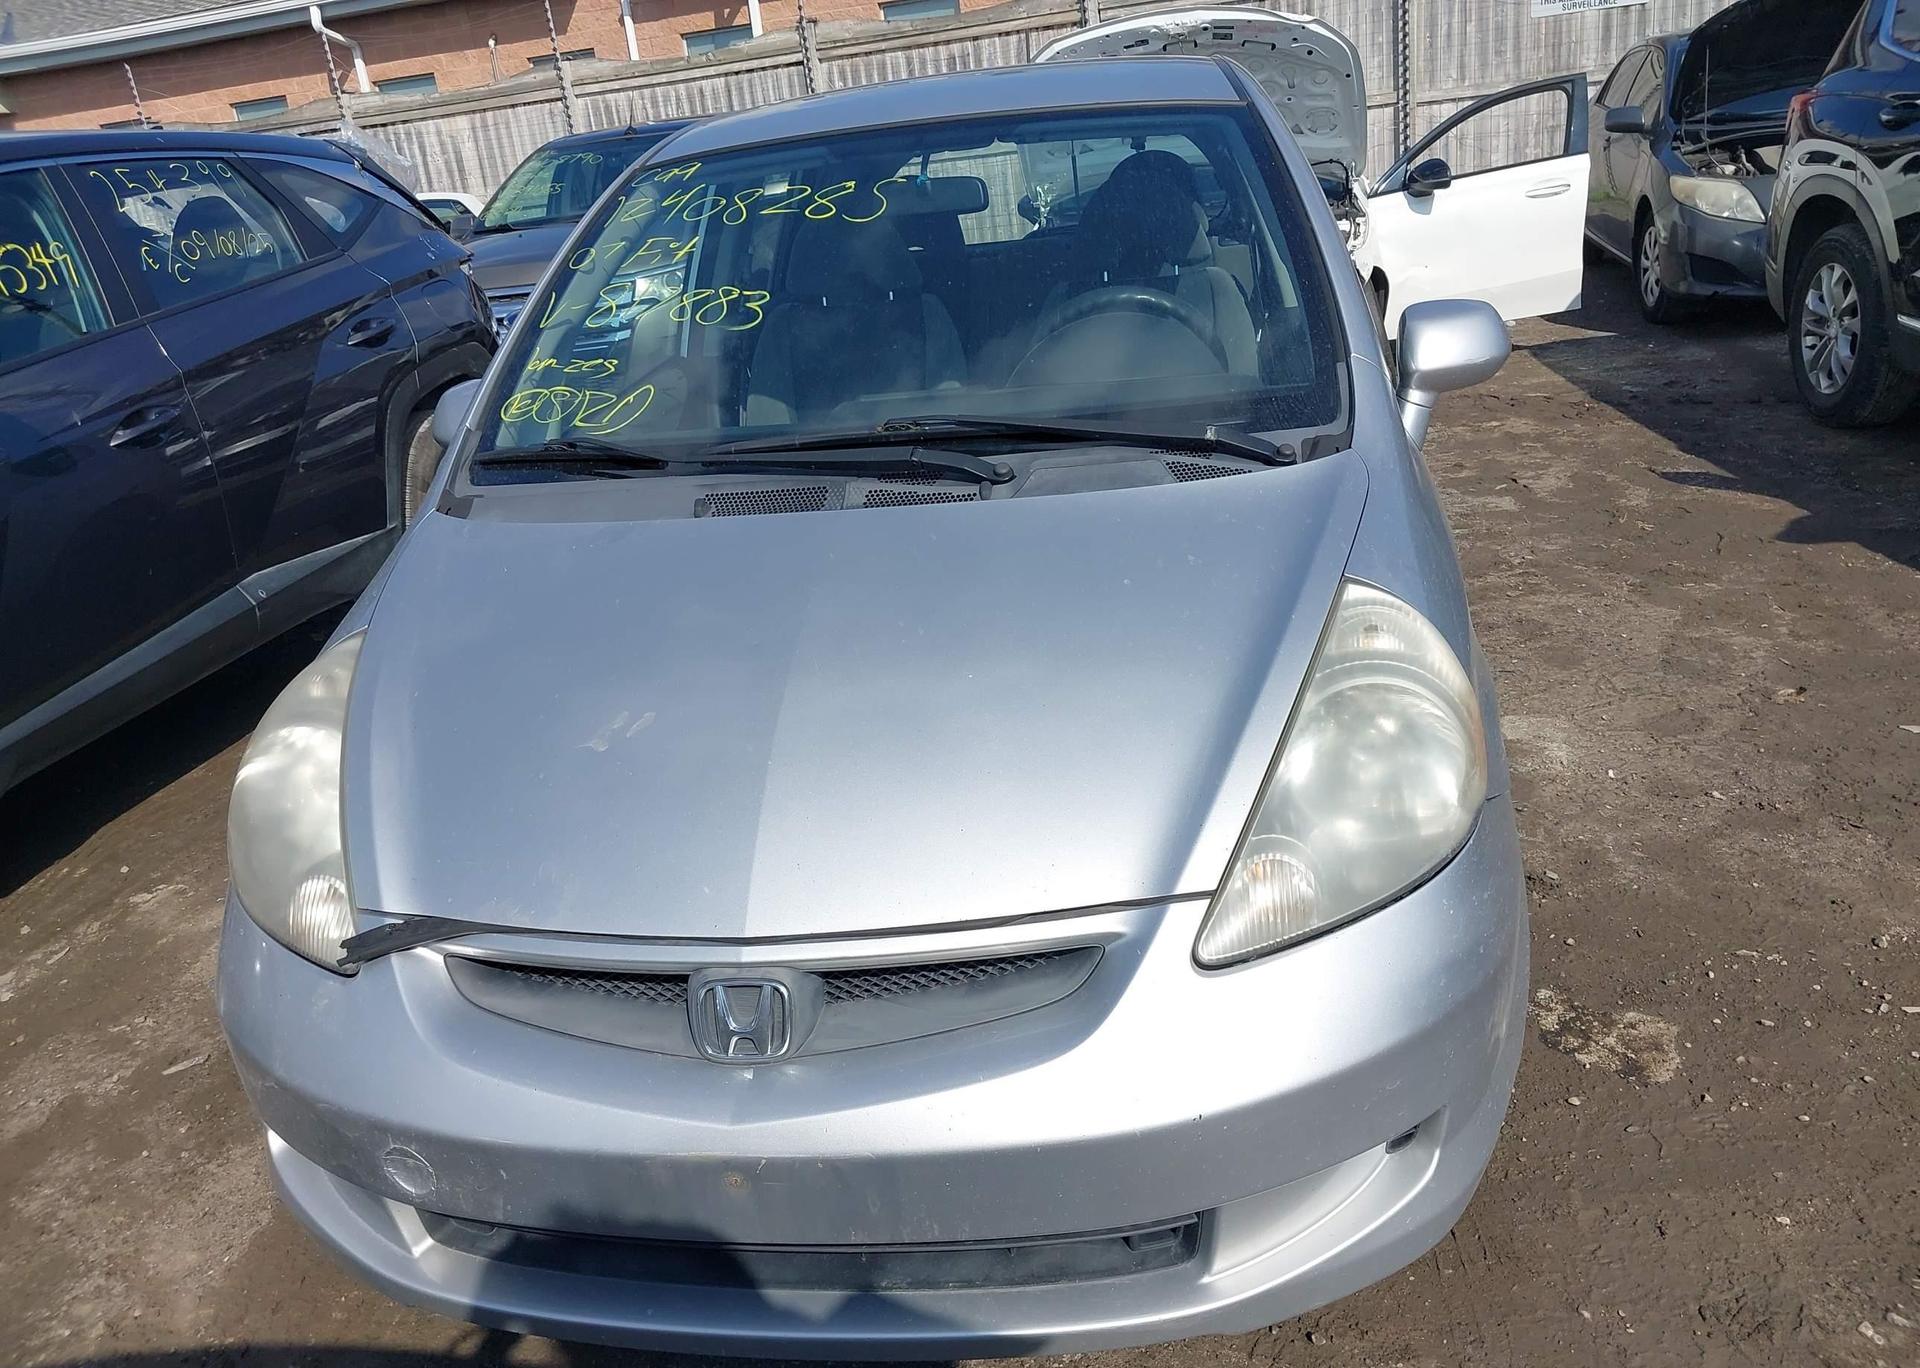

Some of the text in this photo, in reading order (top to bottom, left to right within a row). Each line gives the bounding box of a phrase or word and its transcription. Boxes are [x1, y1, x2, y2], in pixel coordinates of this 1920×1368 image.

[1561, 0, 1618, 11] SURVEILLANCE
[604, 178, 908, 229] 12408285
[180, 226, 275, 262] 09/08/25
[569, 240, 627, 270] 07
